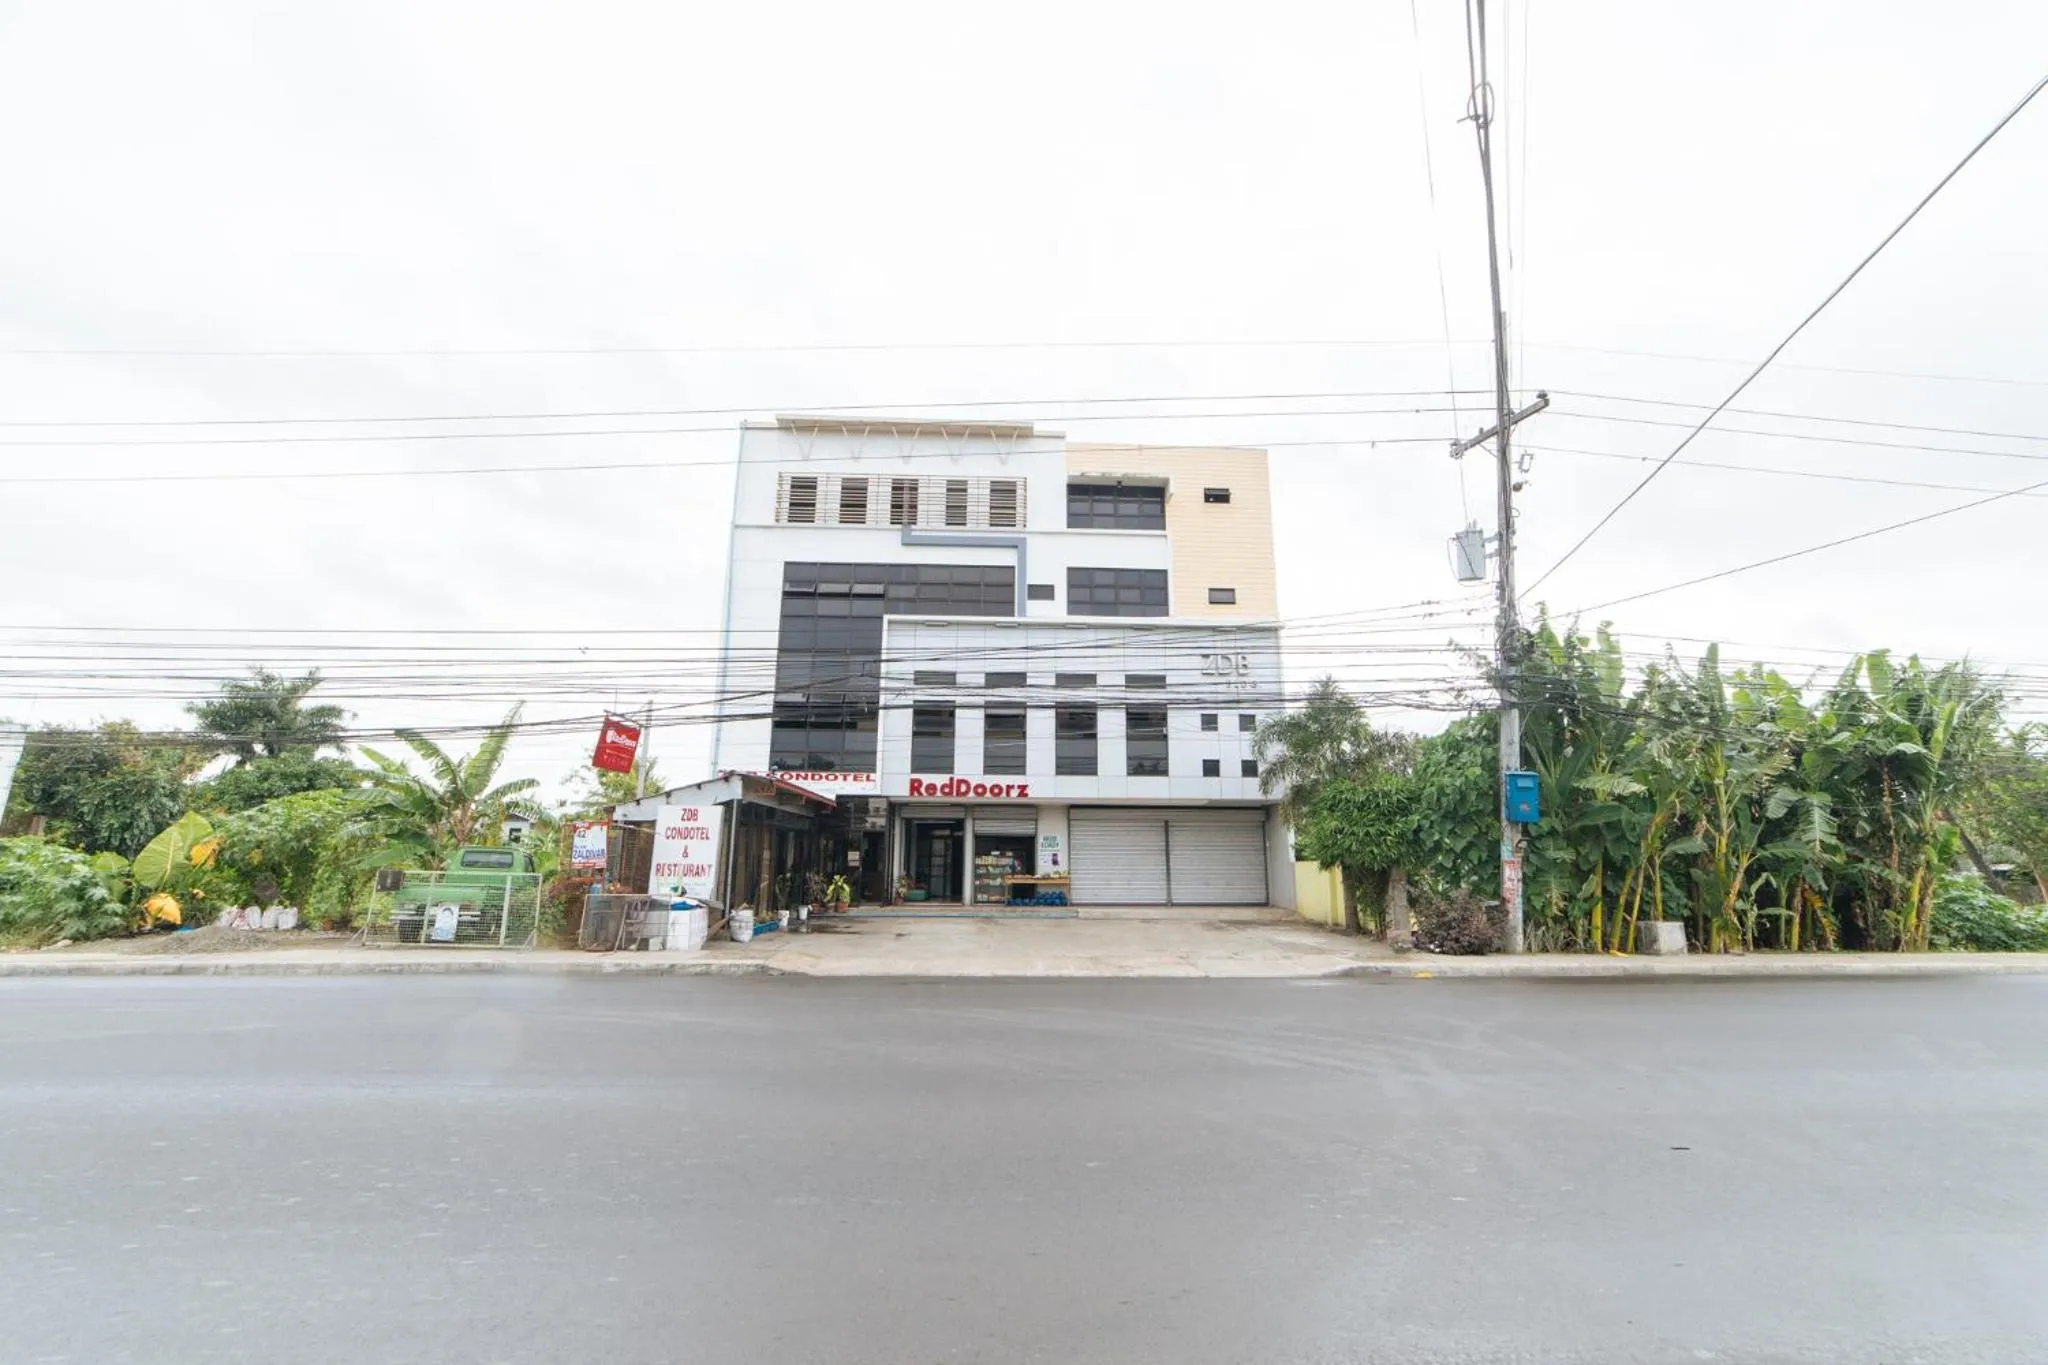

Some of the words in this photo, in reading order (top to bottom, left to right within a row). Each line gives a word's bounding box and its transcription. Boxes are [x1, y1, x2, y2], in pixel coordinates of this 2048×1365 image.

[909, 776, 1029, 798] RedDoorz
[680, 807, 699, 822] ZDB
[665, 826, 711, 840] CONDOTEL
[681, 844, 689, 858] &
[655, 863, 713, 877] RESTURANT
